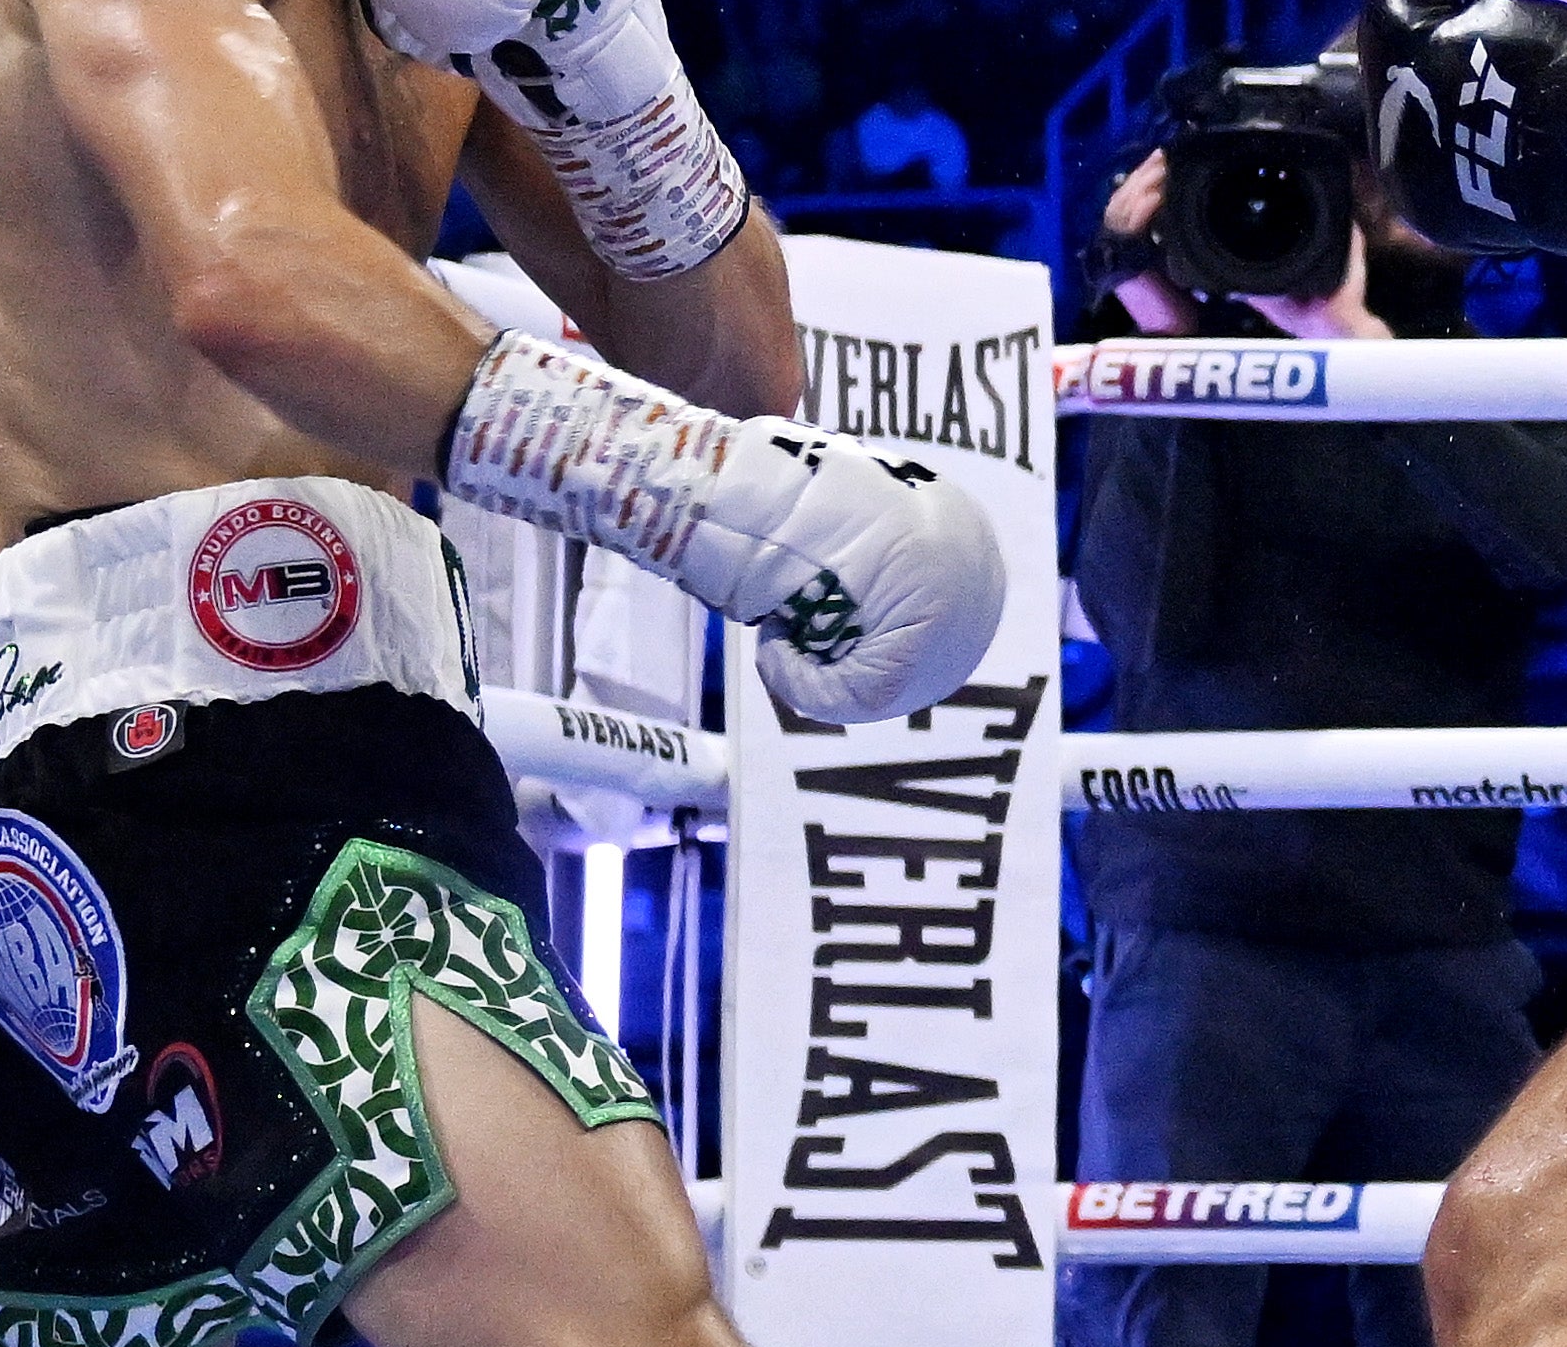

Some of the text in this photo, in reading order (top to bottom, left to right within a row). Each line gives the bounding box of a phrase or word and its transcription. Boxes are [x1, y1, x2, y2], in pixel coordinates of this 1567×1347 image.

[796, 323, 1042, 473] VERLAST
[197, 504, 347, 573] MUNDO BOXING
[553, 703, 689, 766] EVERLAST
[1076, 1183, 1351, 1222] BETFRED
